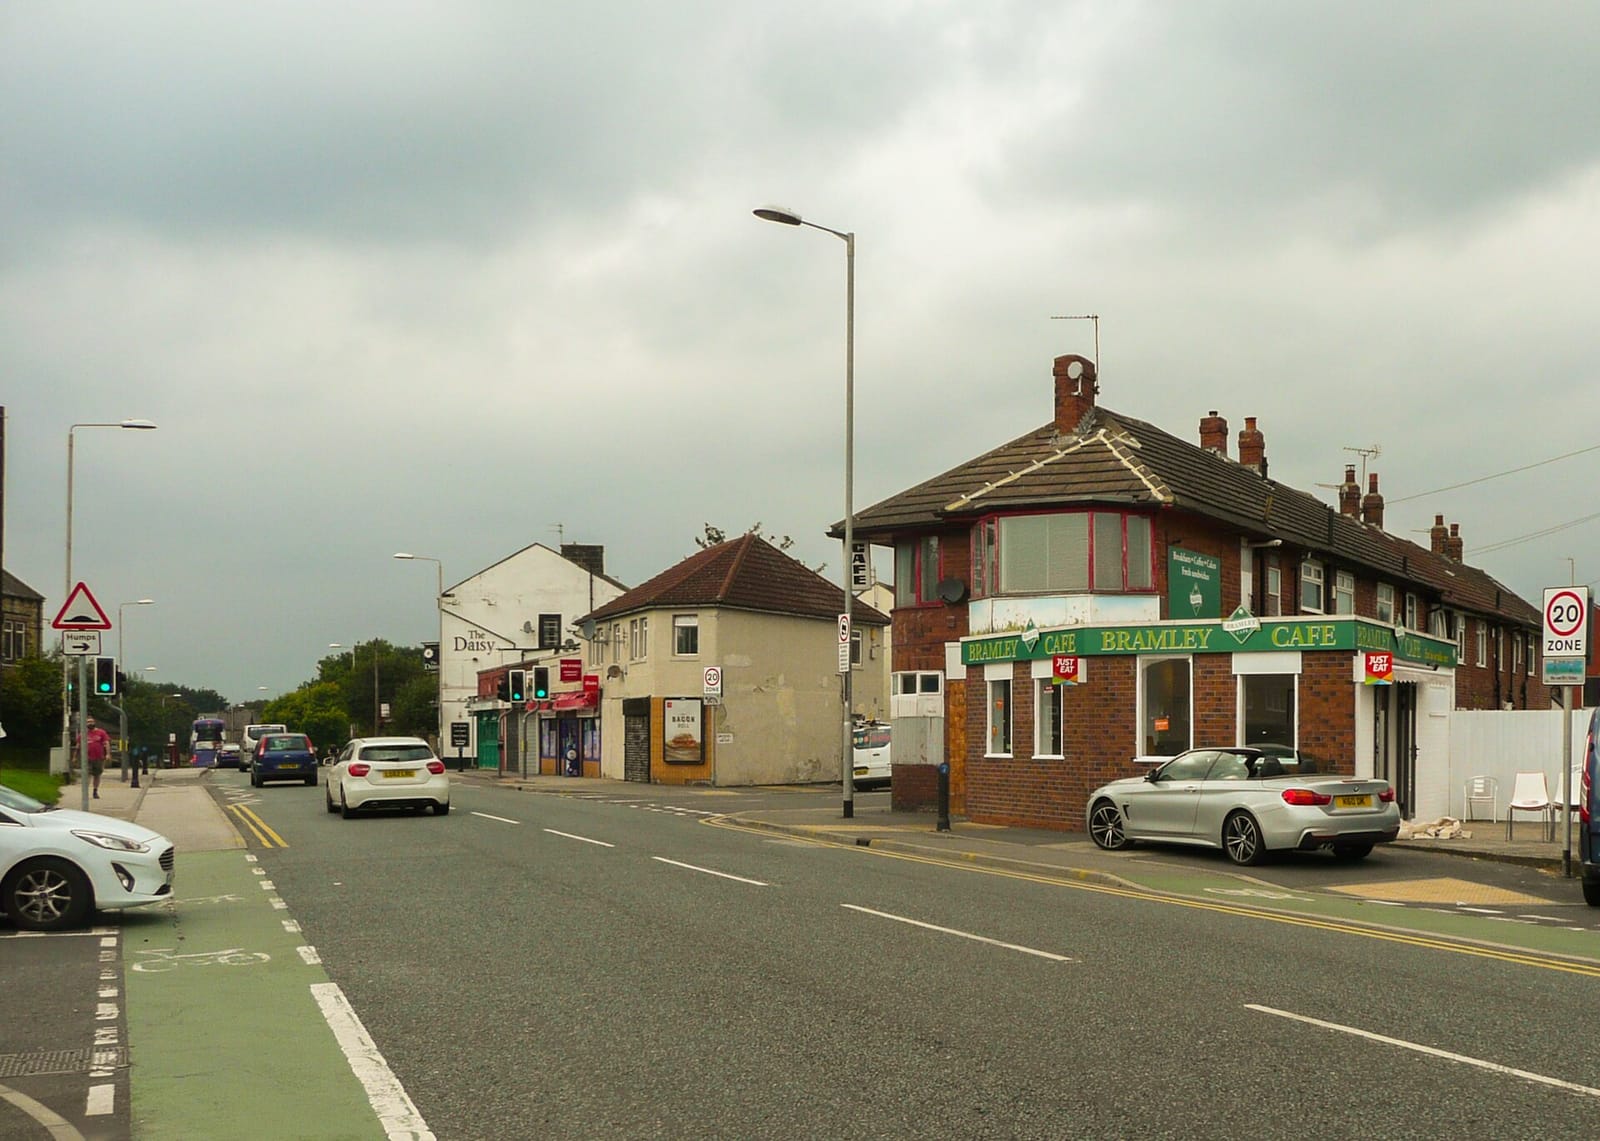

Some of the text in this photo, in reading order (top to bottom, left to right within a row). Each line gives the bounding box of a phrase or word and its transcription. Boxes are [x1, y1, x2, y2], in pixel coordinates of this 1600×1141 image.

[852, 543, 866, 585] CAFE
[1181, 566, 1192, 577] Fresh
[1553, 604, 1579, 623] 20
[467, 630, 486, 639] The
[1101, 625, 1337, 651] BRAMLEY CAFE
[1357, 626, 1392, 652] BRAMLEY
[453, 636, 496, 655] Daisy
[968, 633, 1077, 661] BRAMLEY CAFE
[1547, 639, 1582, 651] ZONE
[1056, 658, 1075, 667] JUST
[1368, 656, 1389, 666] JUST
[1060, 666, 1075, 674] EAT
[1373, 664, 1389, 672] EAT
[707, 673, 718, 681] 20
